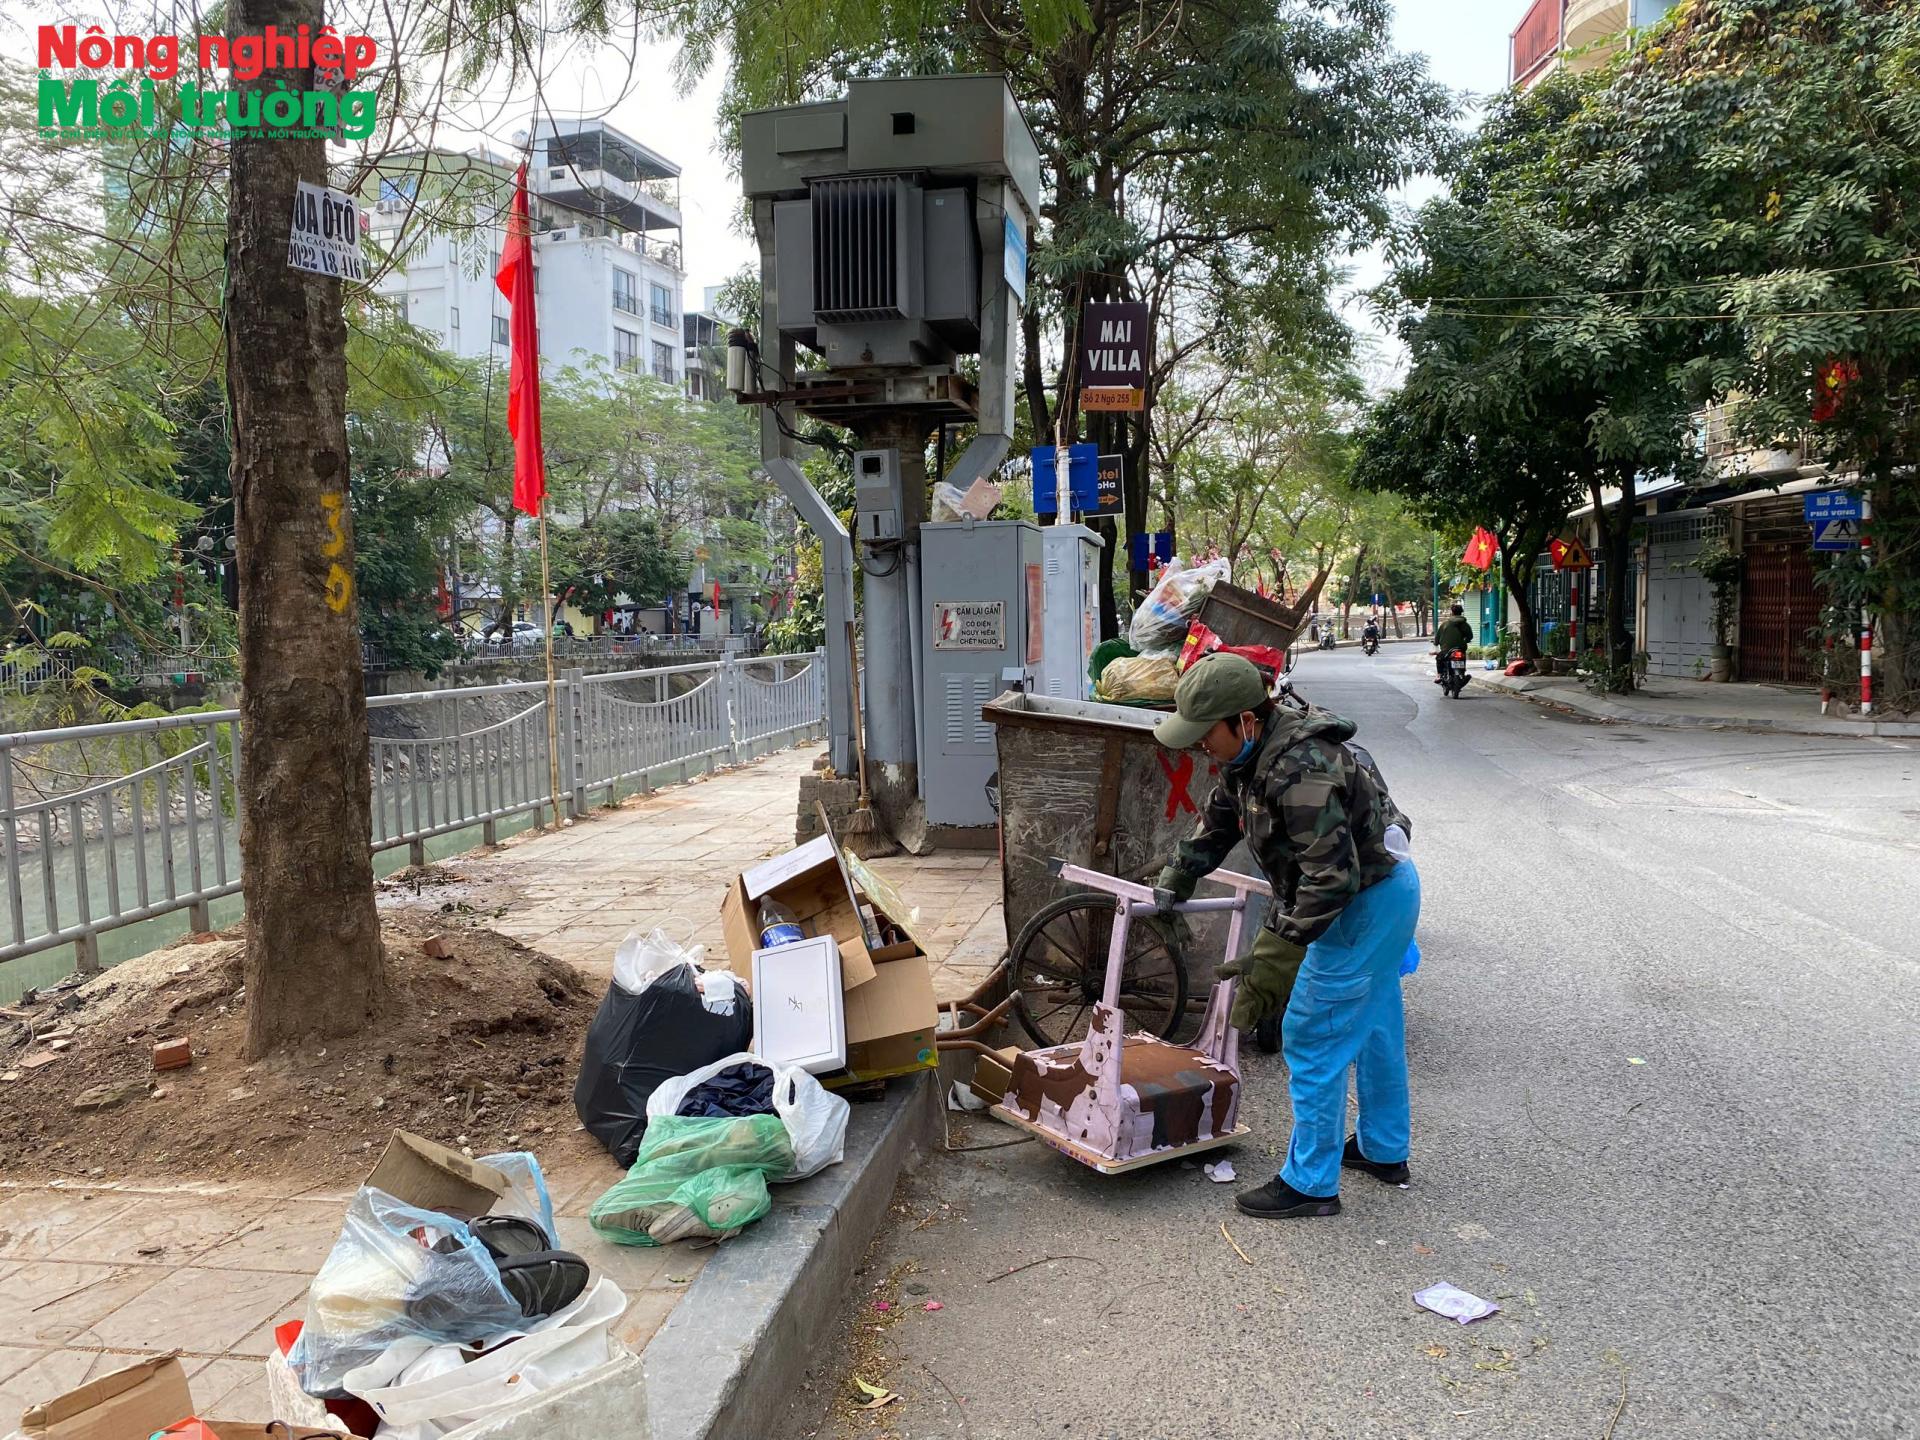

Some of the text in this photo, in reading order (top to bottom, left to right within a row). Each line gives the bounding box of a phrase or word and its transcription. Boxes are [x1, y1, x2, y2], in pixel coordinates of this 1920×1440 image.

[306, 236, 326, 248] CAO
[320, 249, 339, 274] 18
[341, 254, 362, 280] 416
[1100, 320, 1132, 343] MAI
[1087, 349, 1142, 372] VILLA
[1095, 393, 1100, 403] 2
[1117, 393, 1130, 404] 255
